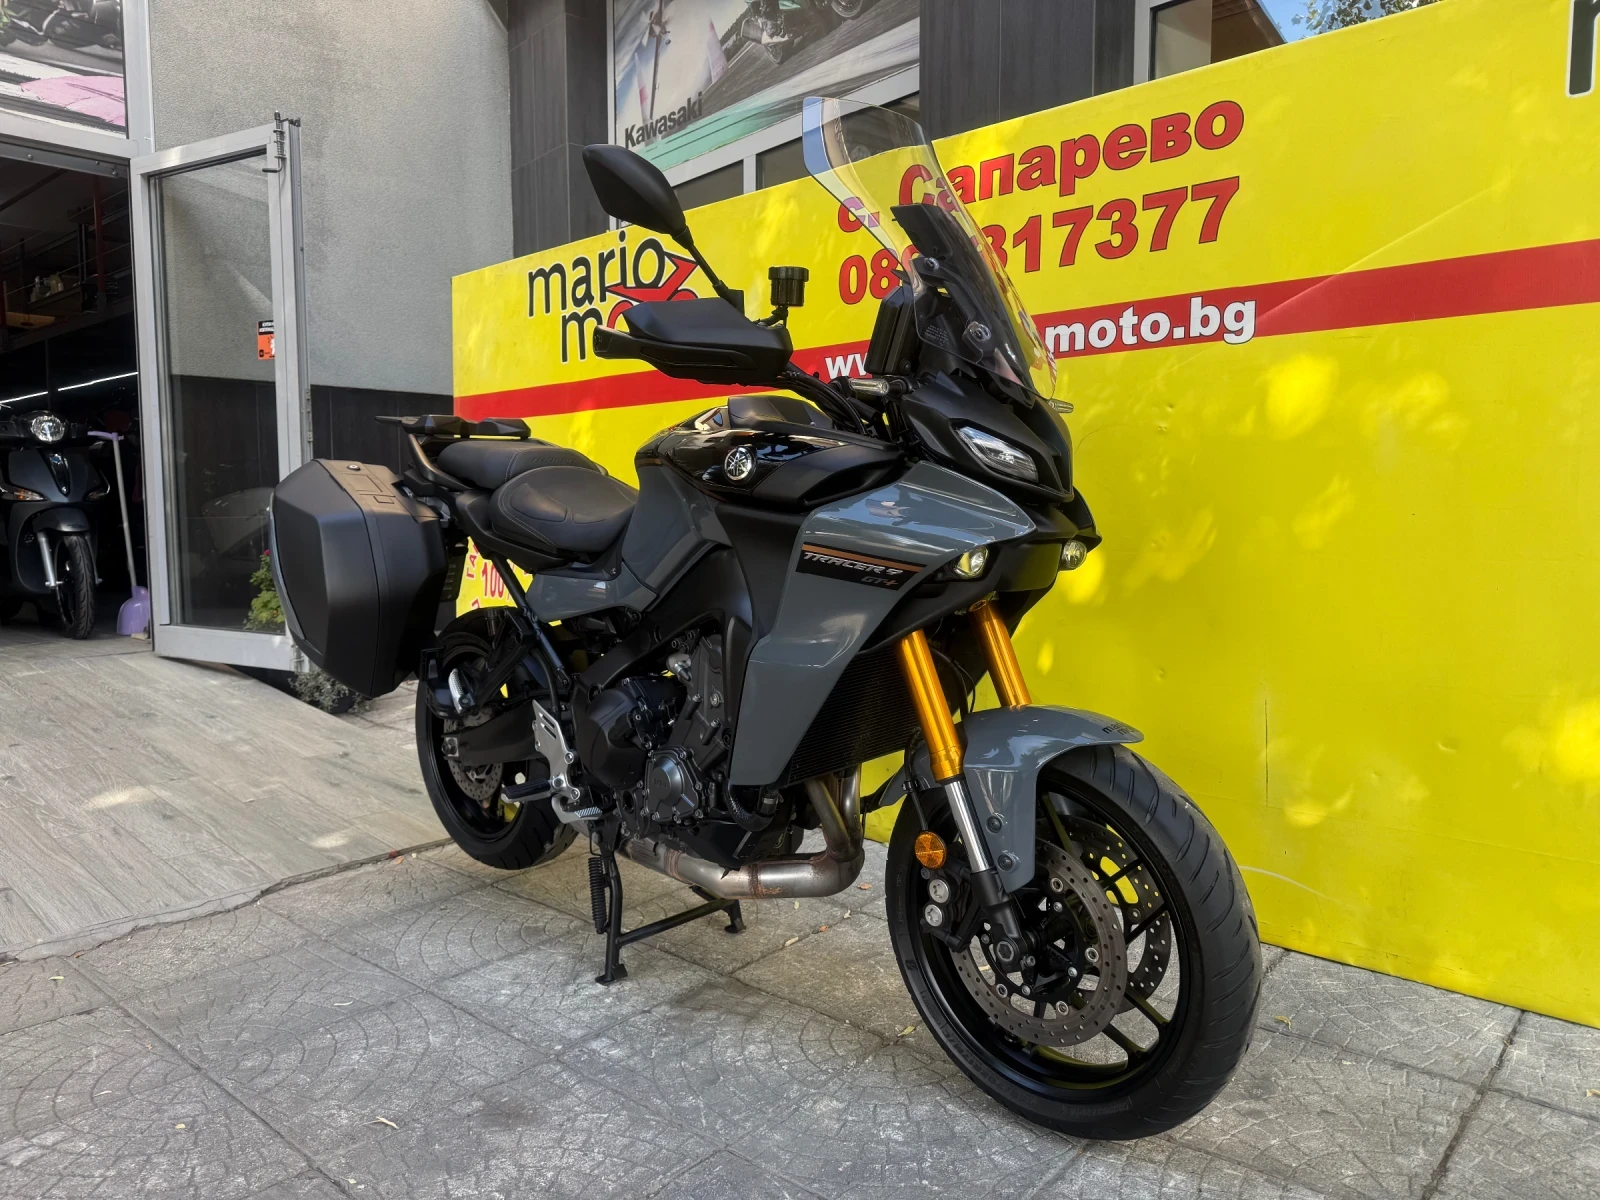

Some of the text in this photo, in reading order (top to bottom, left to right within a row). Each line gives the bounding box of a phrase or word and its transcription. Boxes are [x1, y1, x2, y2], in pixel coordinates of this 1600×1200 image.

[625, 91, 703, 149] Kawasaki
[899, 100, 1244, 208] Сапарево
[528, 230, 667, 317] mario
[803, 552, 904, 576] TRACER 9
